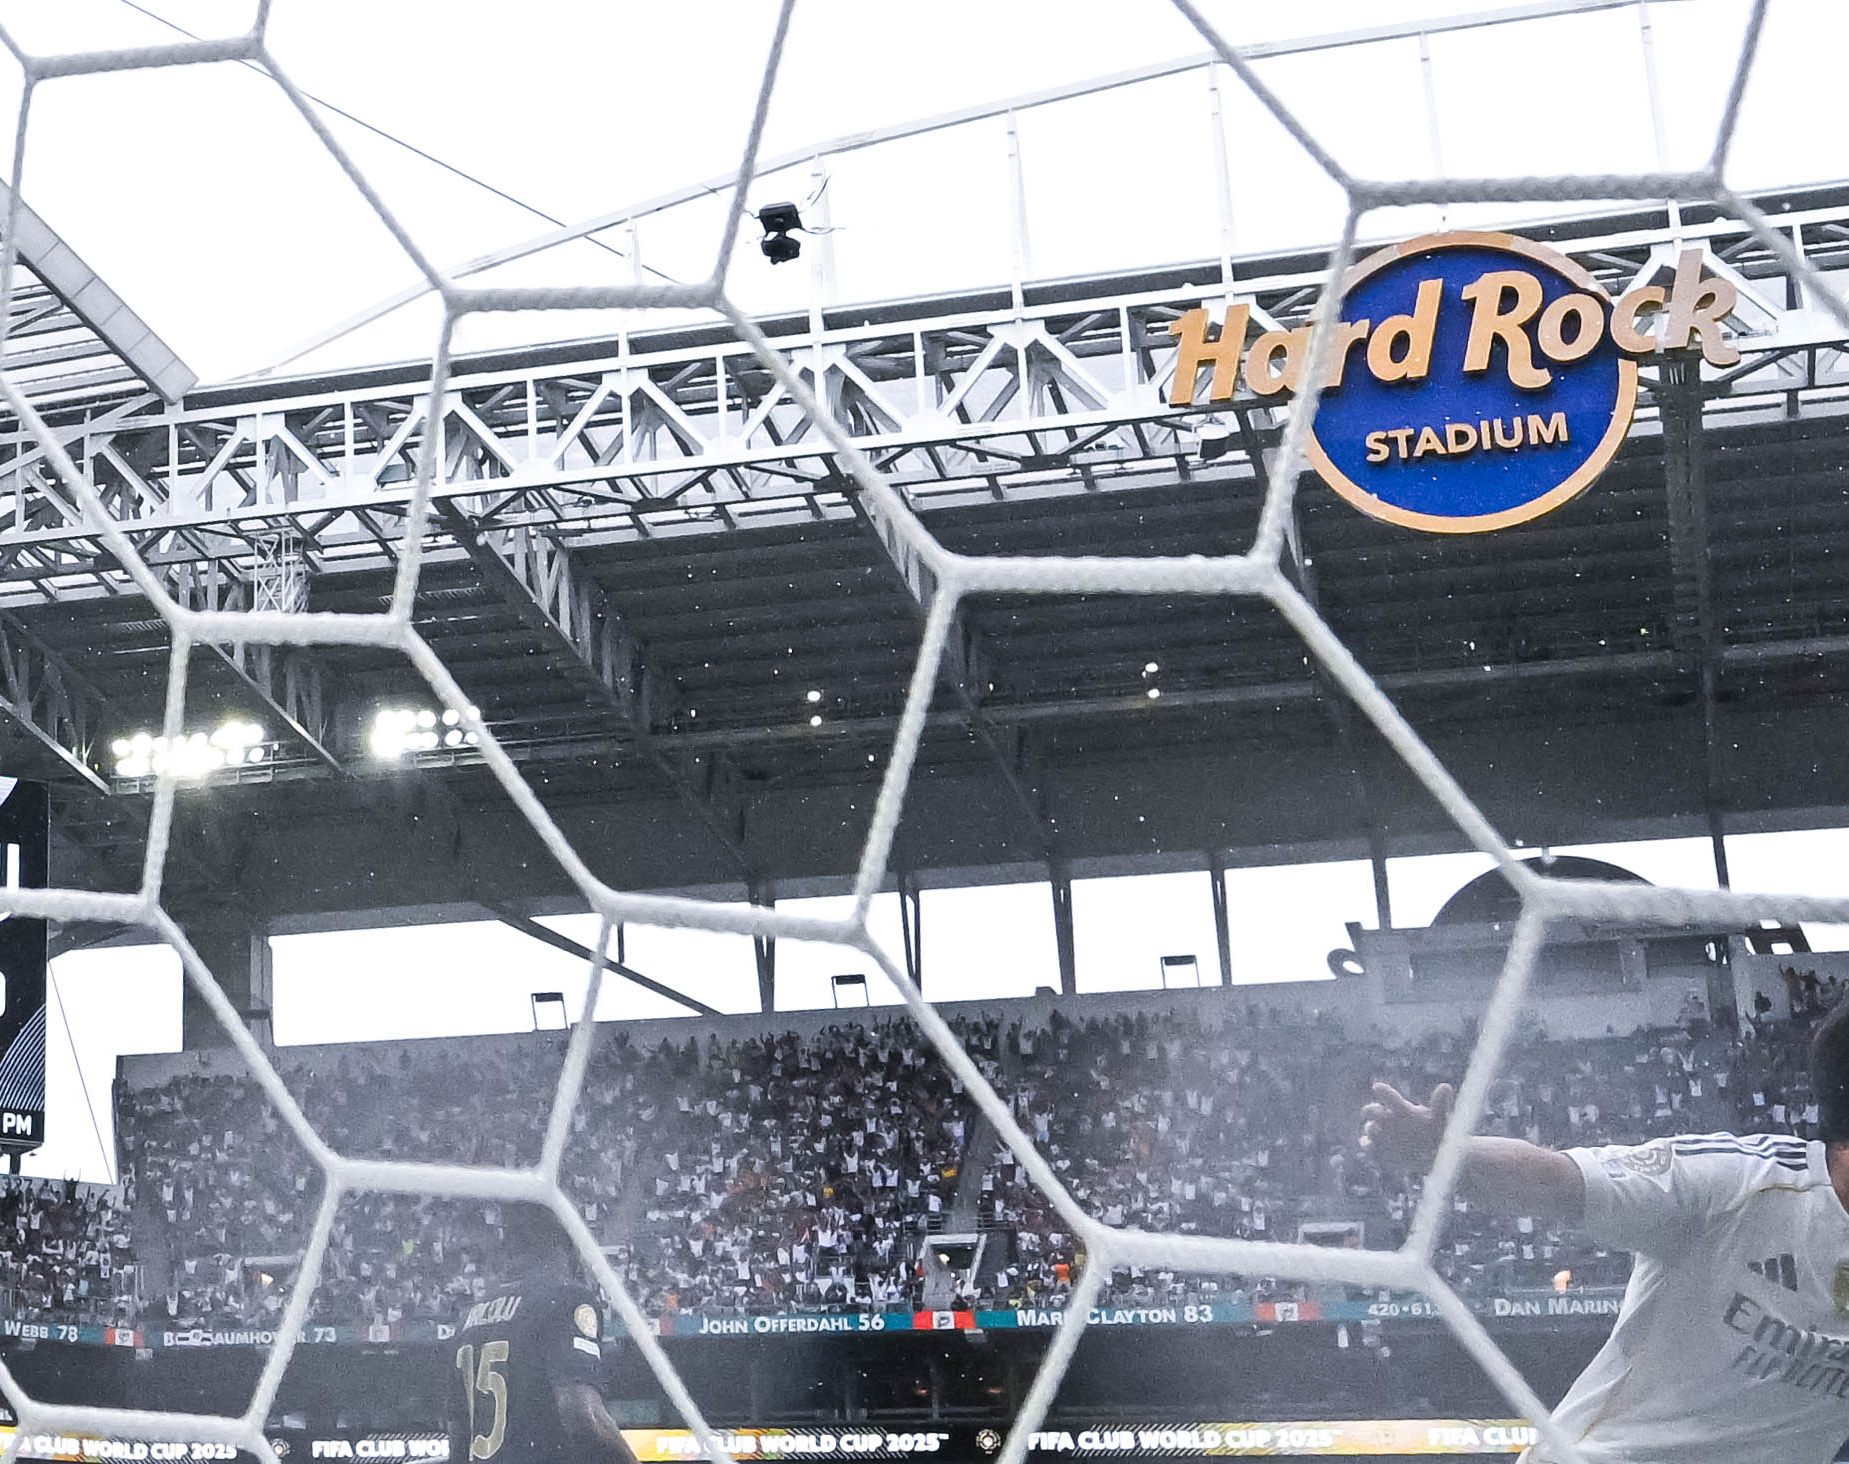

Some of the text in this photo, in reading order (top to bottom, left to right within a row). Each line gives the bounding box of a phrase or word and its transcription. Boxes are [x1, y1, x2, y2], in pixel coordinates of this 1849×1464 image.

[1169, 249, 1741, 406] Hard Rock
[1364, 411, 1569, 463] STADIUM
[2, 1111, 33, 1136] PM
[857, 1312, 886, 1332] 56
[1183, 1303, 1214, 1325] 83
[57, 1324, 79, 1343] 78
[313, 1327, 337, 1342] 73
[455, 1340, 510, 1462] 15
[761, 1434, 837, 1454] WORLD
[838, 1433, 884, 1454] CUP
[1028, 1431, 1076, 1452] FIFA
[1077, 1430, 1134, 1451] CLUB
[1136, 1429, 1220, 1451] WORLD
[1224, 1428, 1272, 1449] CUP
[1427, 1426, 1480, 1447] FIFA
[34, 1438, 80, 1457] CLUB
[82, 1438, 150, 1462] WORLD
[151, 1441, 189, 1461] CUP
[312, 1439, 352, 1459] FIFA
[355, 1439, 405, 1459] CLUB
